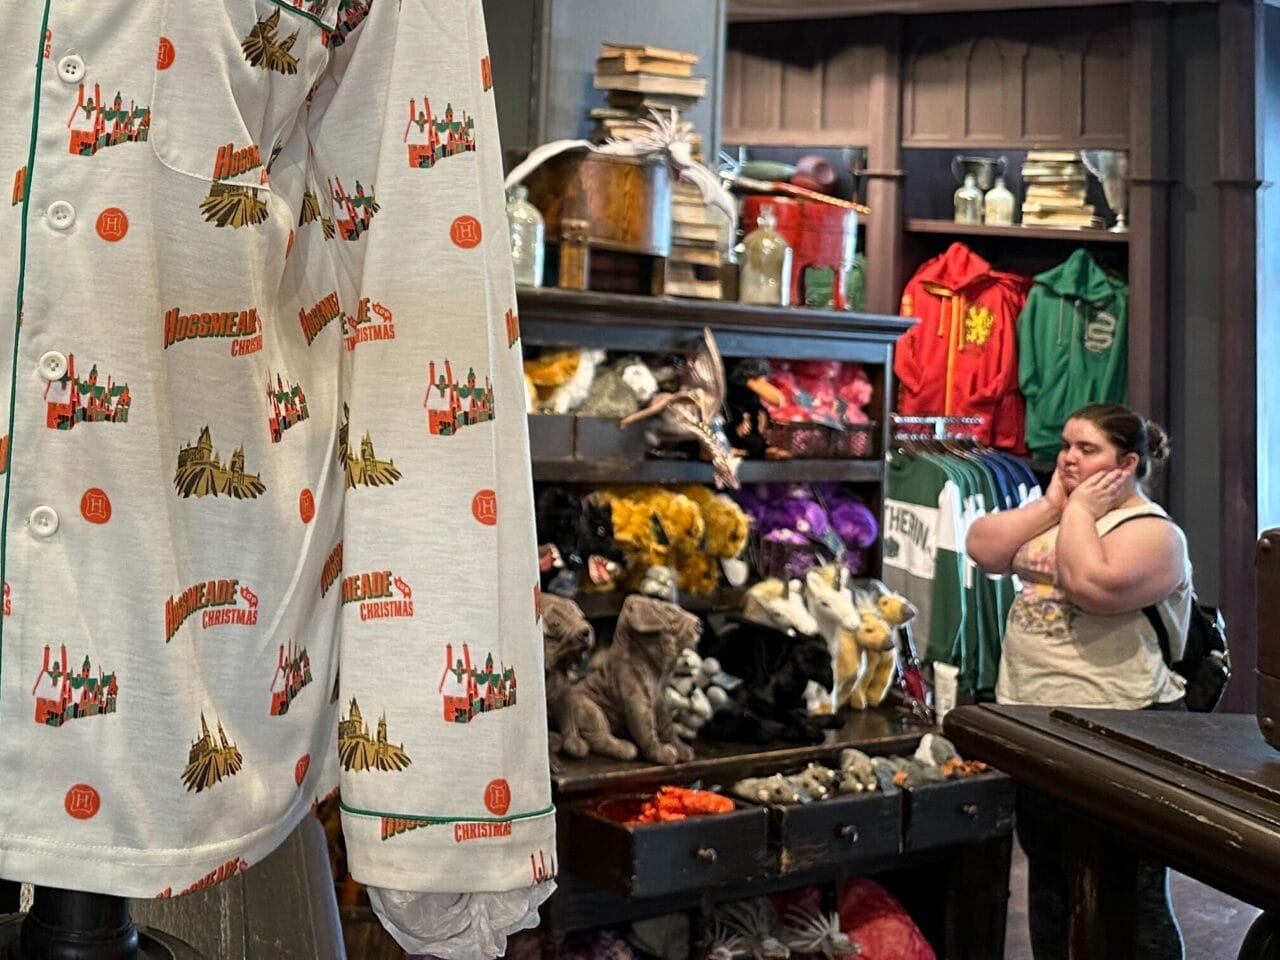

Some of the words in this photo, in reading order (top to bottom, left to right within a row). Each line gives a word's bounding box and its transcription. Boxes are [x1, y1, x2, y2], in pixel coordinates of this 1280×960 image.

[165, 579, 239, 643] HOGSMEADE
[202, 608, 258, 630] CHRISTMAS
[360, 602, 414, 622] CHRISTMAS
[454, 823, 513, 842] CHRISTMAS
